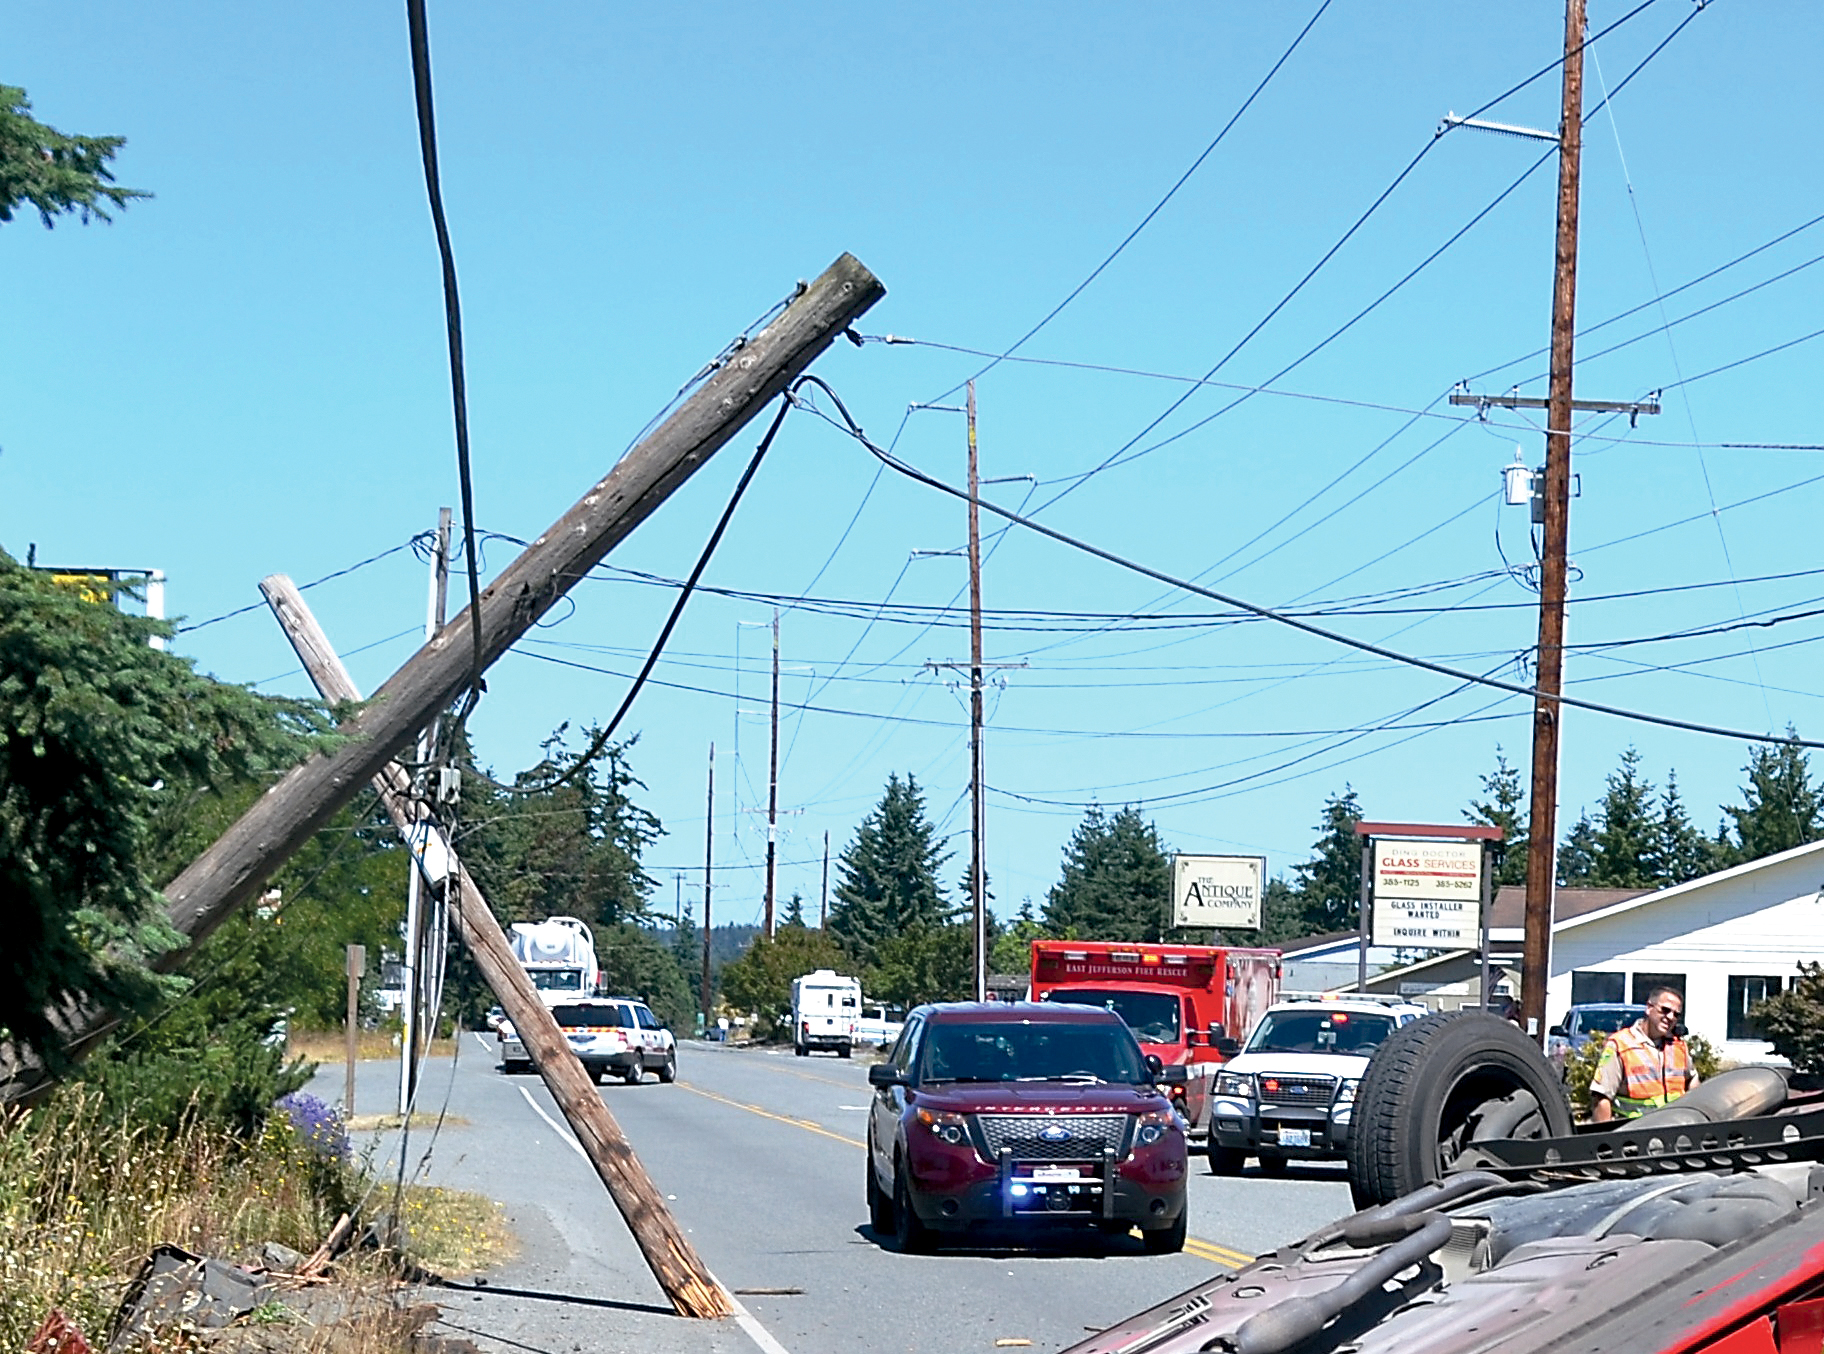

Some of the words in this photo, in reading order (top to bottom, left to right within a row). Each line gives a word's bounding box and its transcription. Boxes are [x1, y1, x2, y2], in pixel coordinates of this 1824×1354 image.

[1392, 848, 1418, 857] DING
[1422, 850, 1466, 858] DOCTOR
[1382, 857, 1420, 868] GLASS
[1424, 858, 1476, 870] SERVICES
[1184, 882, 1253, 907] ANTIQUE
[1207, 899, 1254, 909] COMPANY
[1391, 901, 1416, 910] GLASS
[1420, 902, 1463, 912] INSTALLER
[1408, 910, 1440, 919] WANTED
[1393, 928, 1427, 937] INQUIRE
[1432, 929, 1461, 938] WITHIN
[1066, 963, 1086, 973] EAST
[1088, 965, 1133, 975] JEFFERSON
[1135, 967, 1154, 976] FIRE
[1157, 967, 1188, 977] RESCUE
